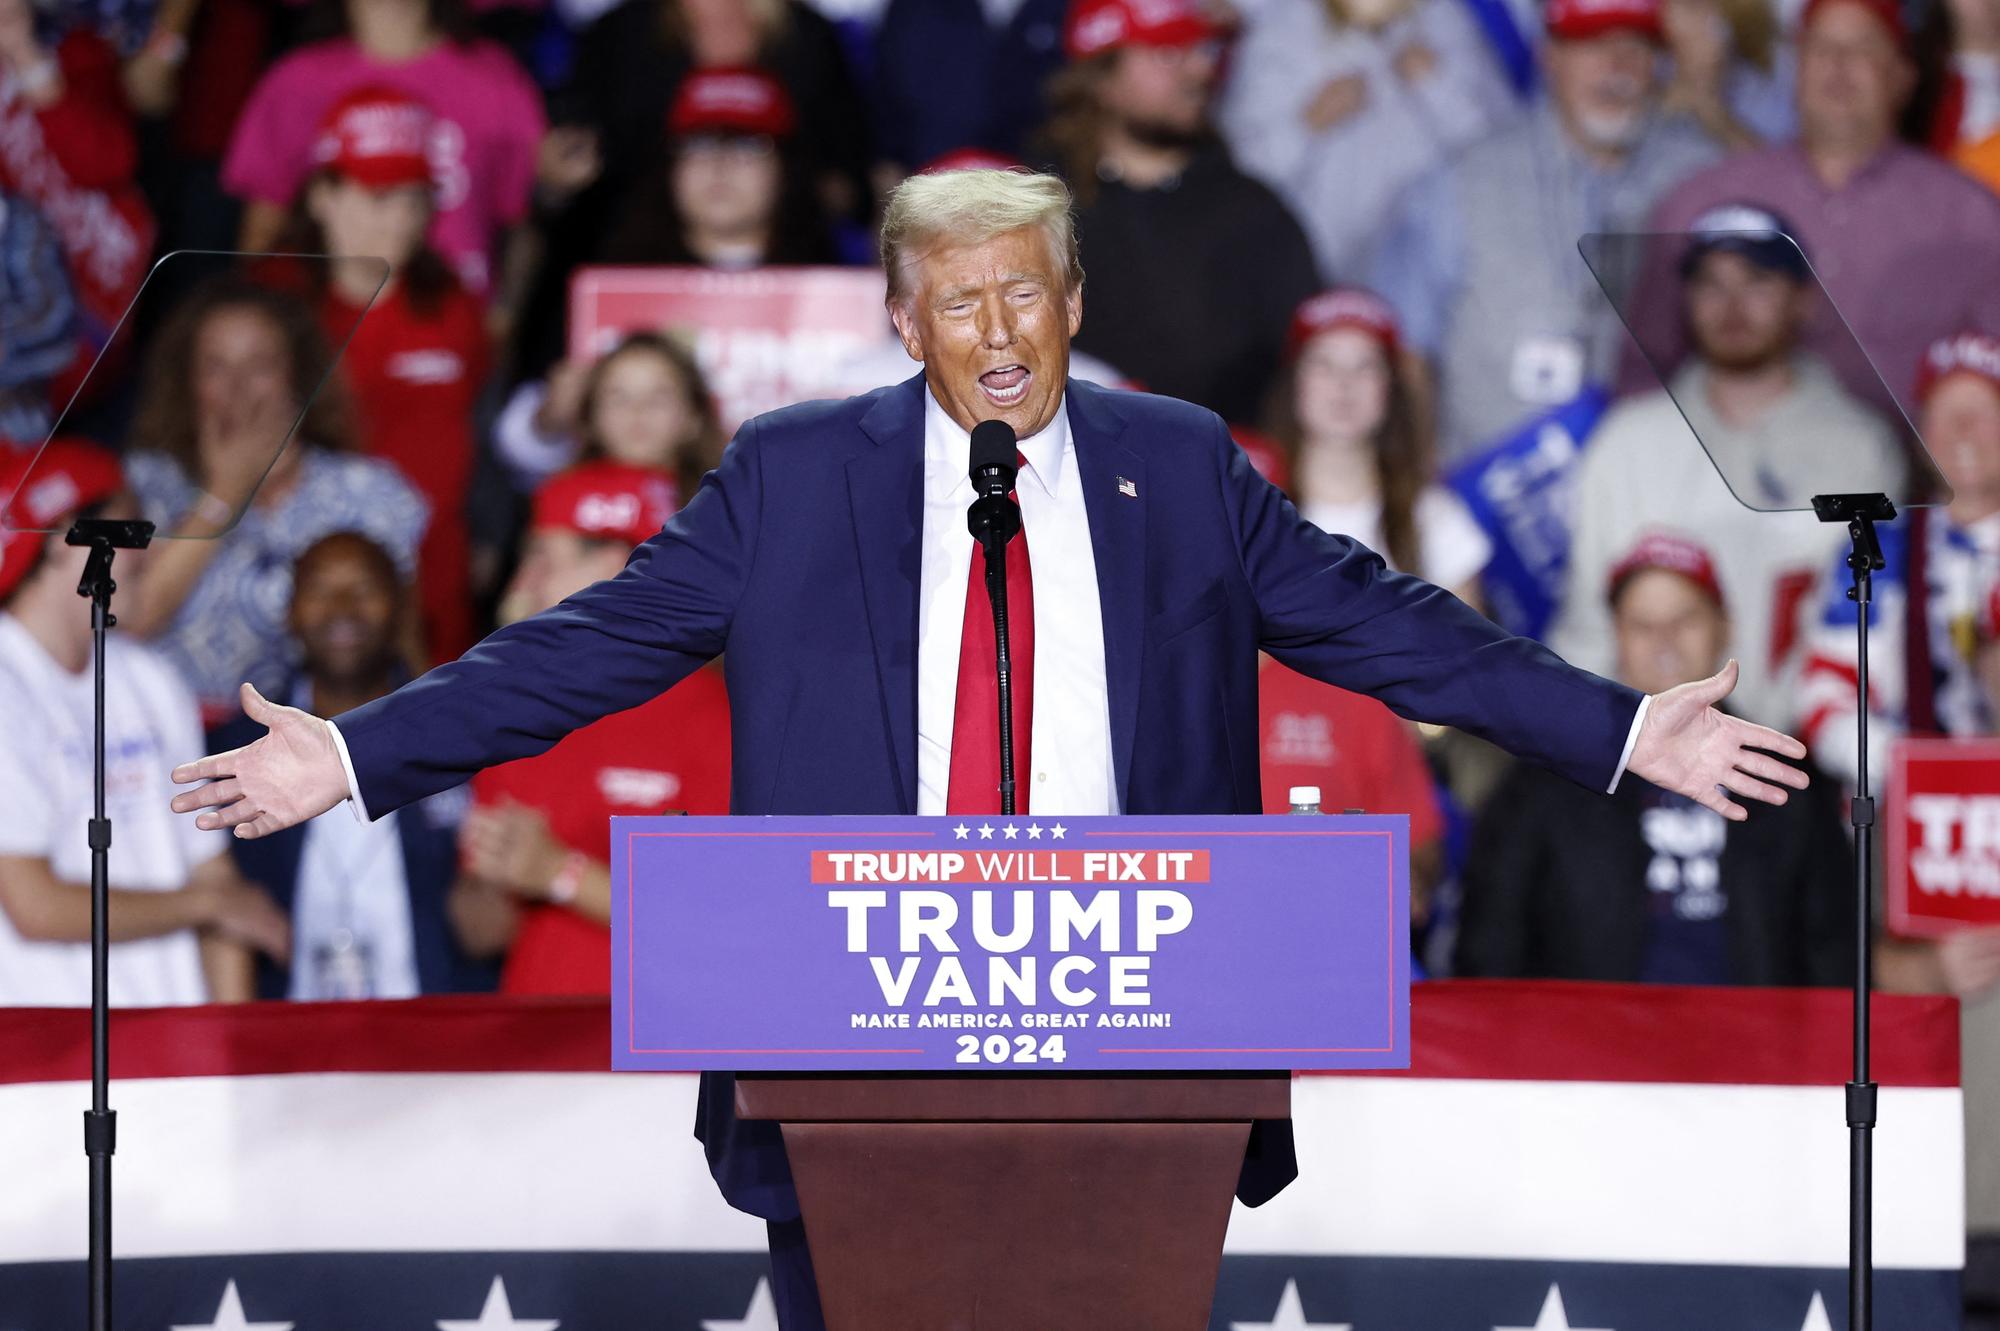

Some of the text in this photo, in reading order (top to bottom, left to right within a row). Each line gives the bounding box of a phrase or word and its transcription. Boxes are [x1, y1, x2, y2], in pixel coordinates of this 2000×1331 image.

[827, 852, 1193, 882] TRUMP WILL FIX IT
[828, 889, 1194, 953] TRUMP
[868, 955, 1152, 1007] VANCE
[851, 1013, 1171, 1029] MAKE AMERICA GREAT AGAIN!
[955, 1034, 1067, 1064] 2024
